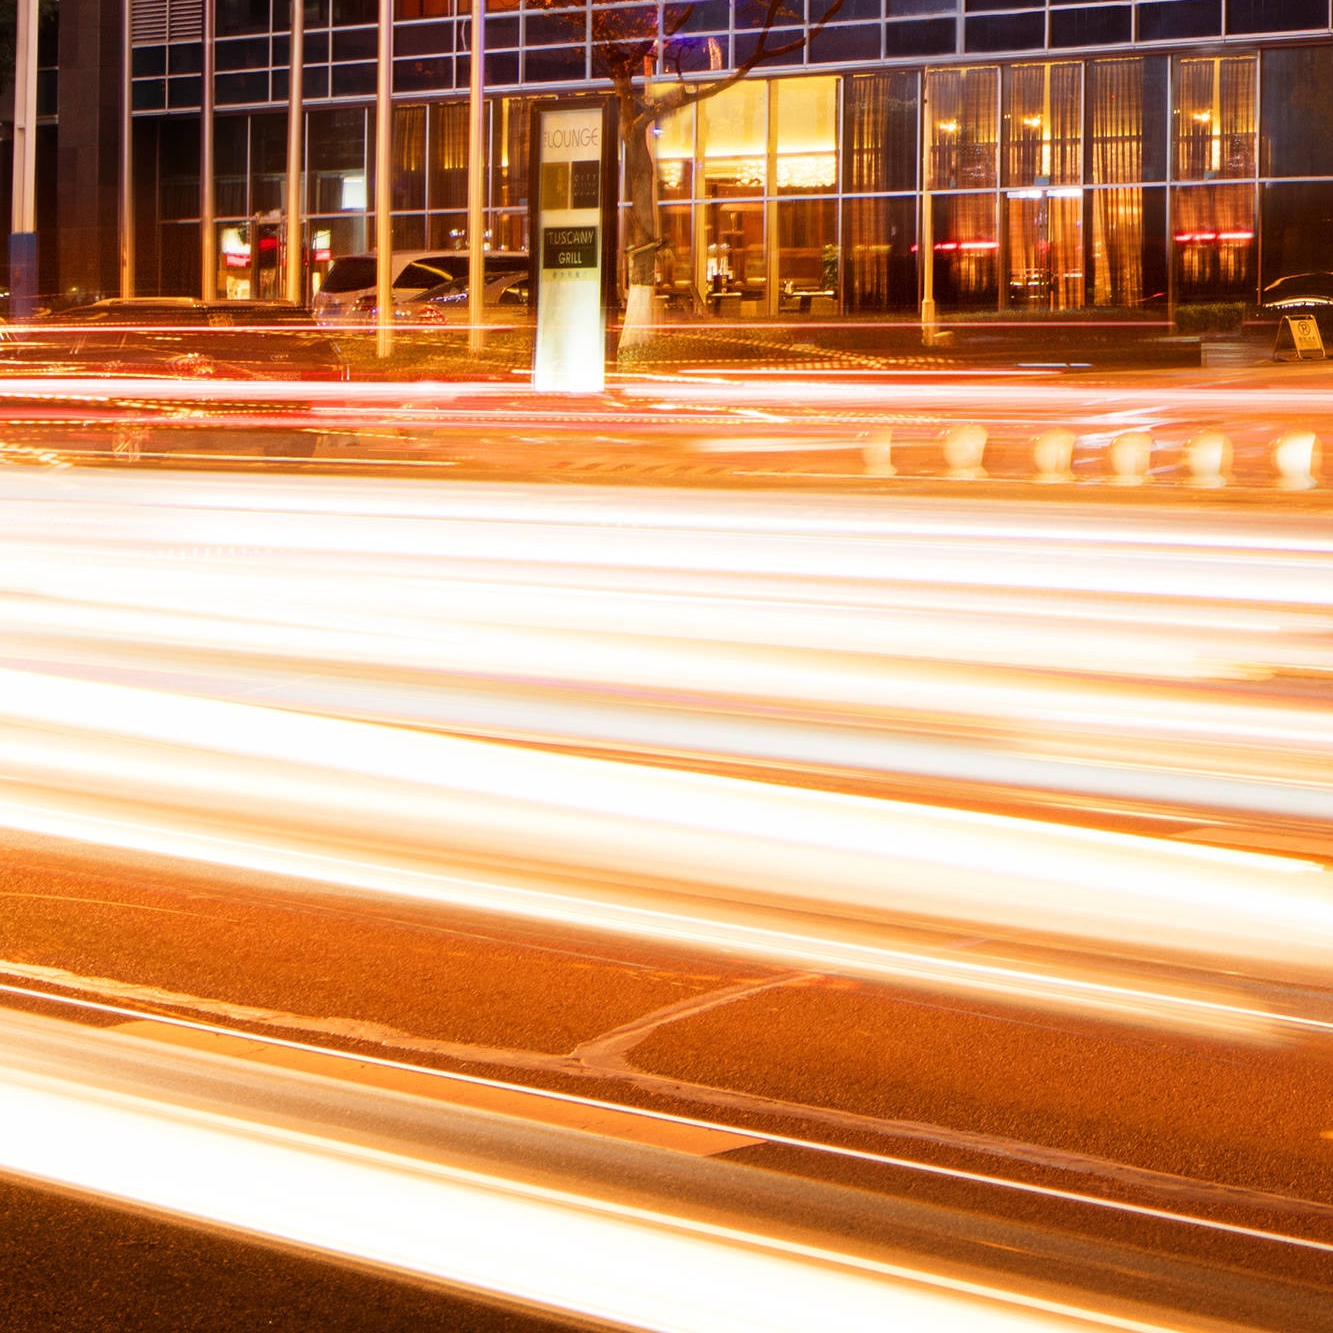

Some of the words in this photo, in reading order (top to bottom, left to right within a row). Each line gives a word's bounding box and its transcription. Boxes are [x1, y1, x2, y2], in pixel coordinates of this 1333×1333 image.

[548, 127, 598, 148] LOUNGE
[547, 230, 594, 245] TUSCANY
[558, 252, 582, 265] GRILL
